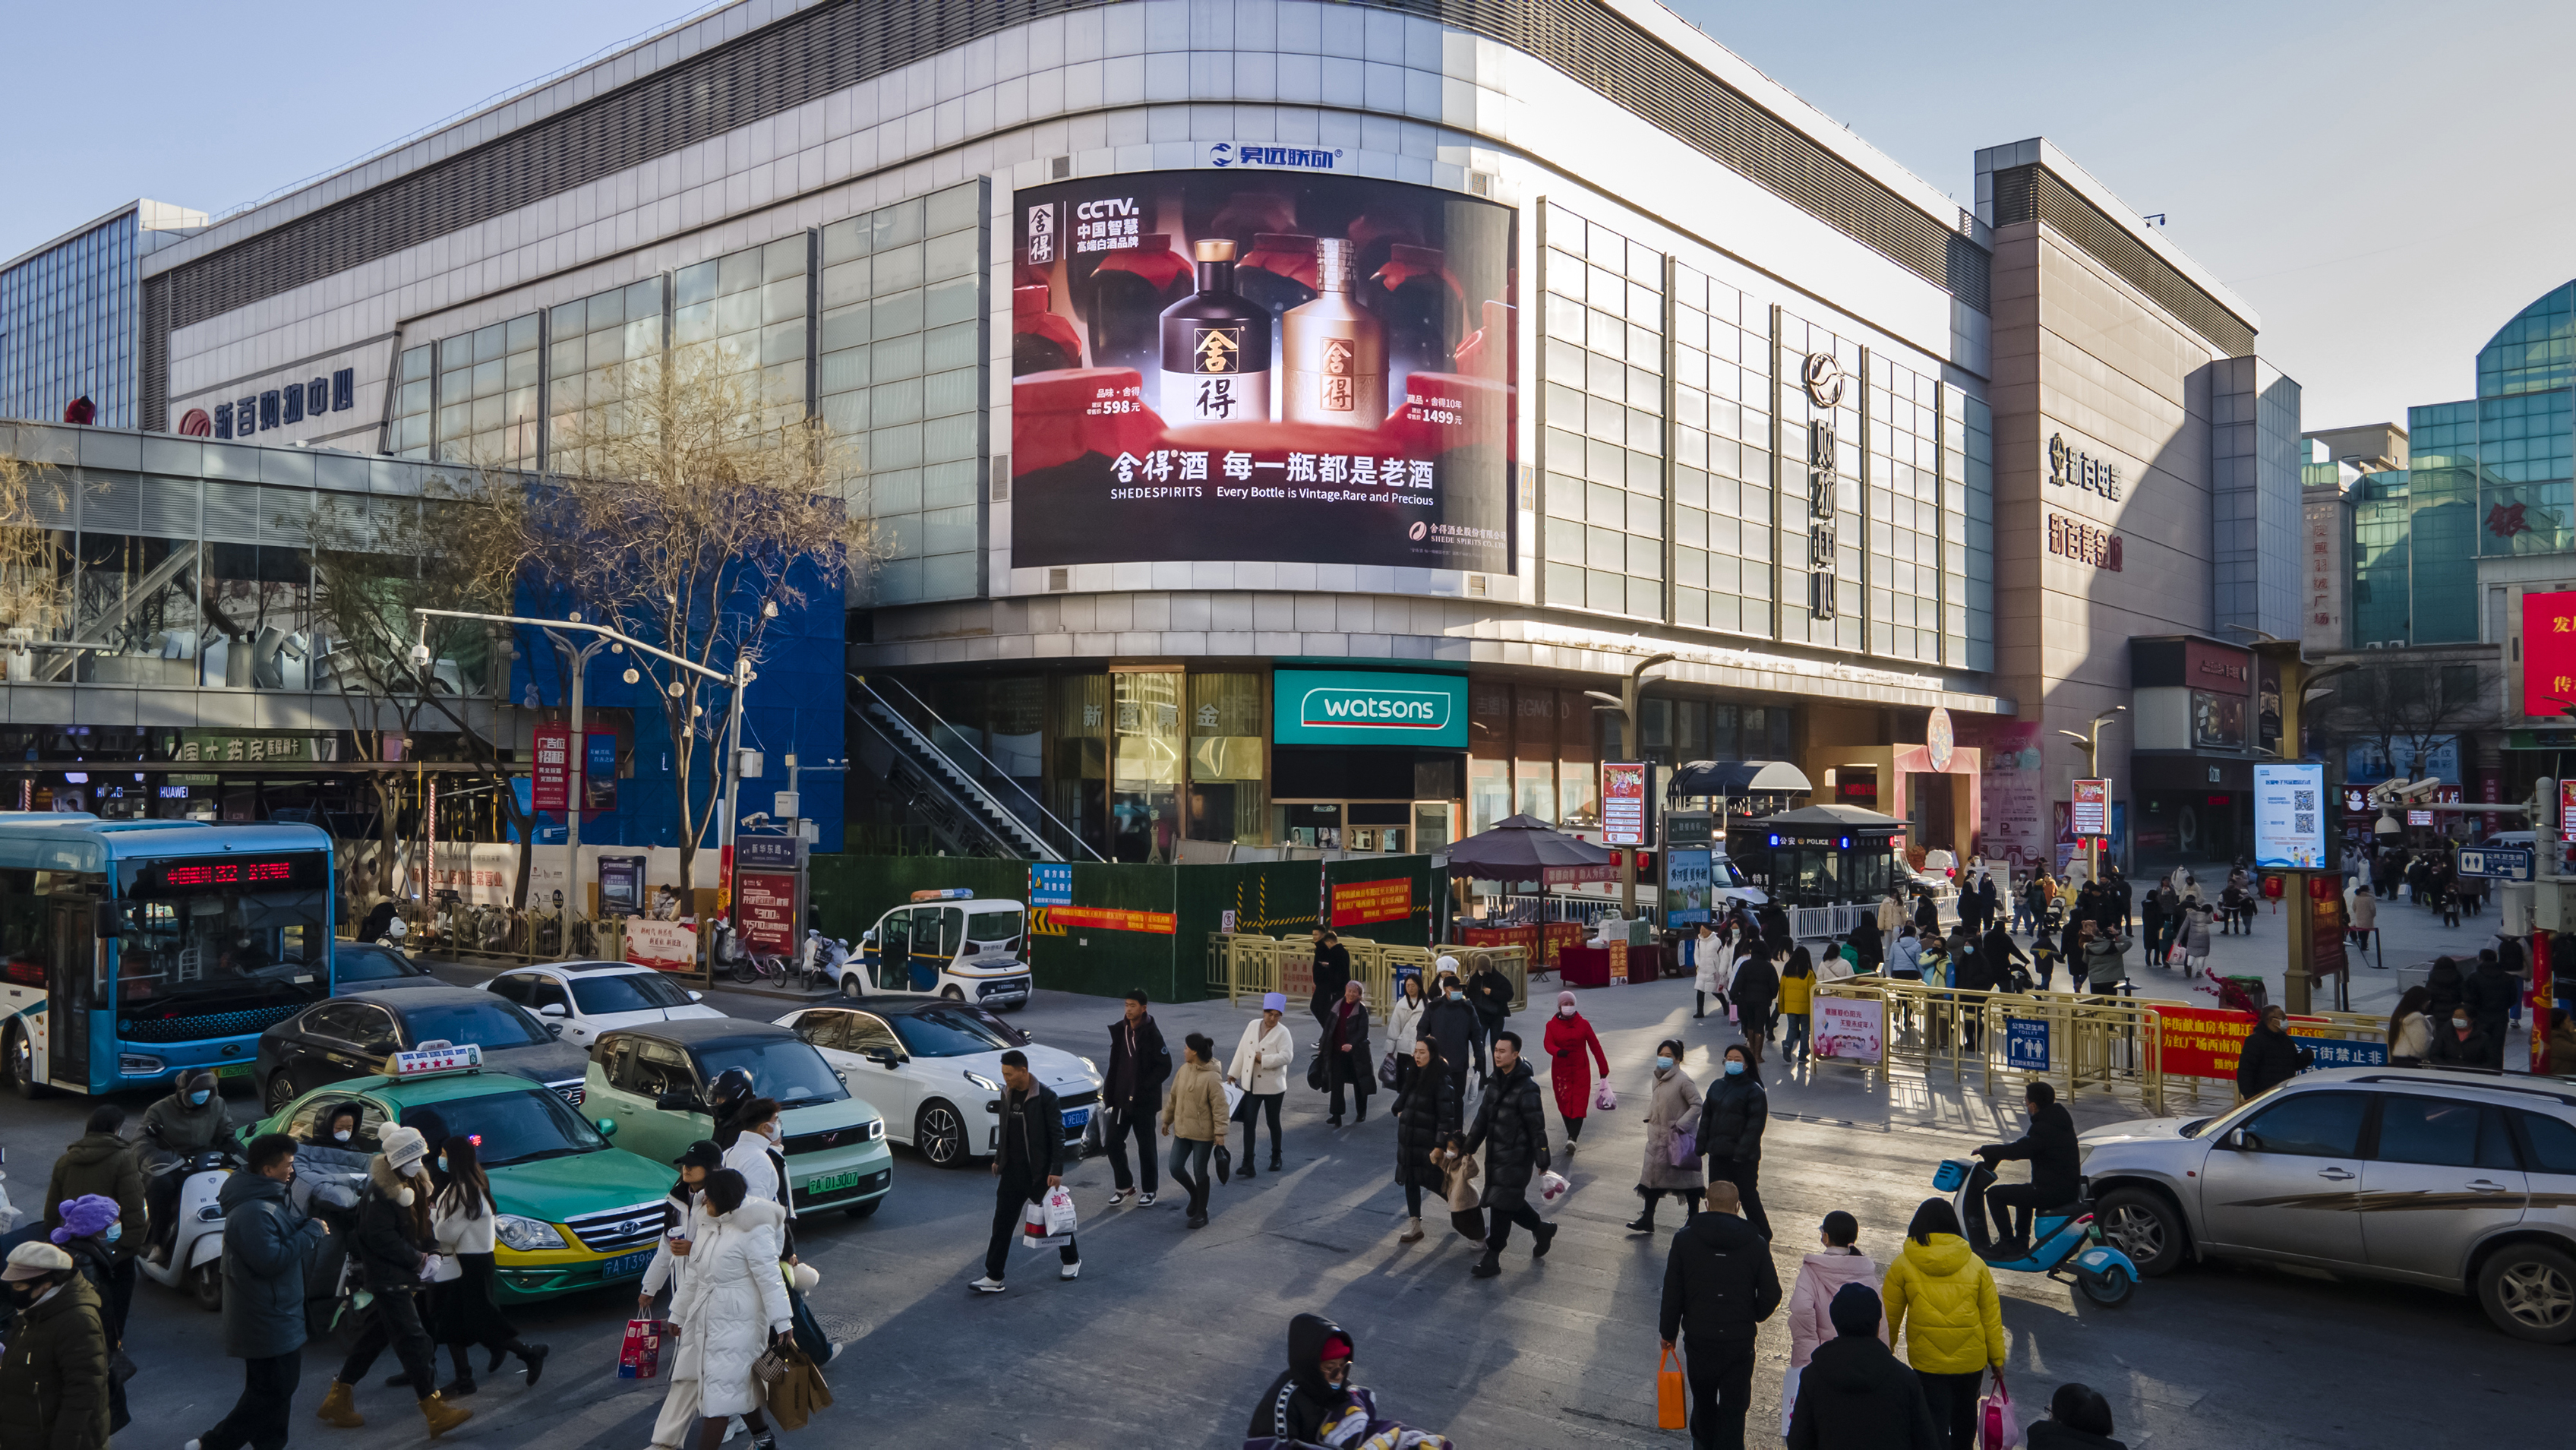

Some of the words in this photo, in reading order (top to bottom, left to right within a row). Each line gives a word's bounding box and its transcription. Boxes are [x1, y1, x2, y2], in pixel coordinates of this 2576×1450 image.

[1077, 218, 1138, 239] 中国智慧
[1077, 236, 1139, 253] 高端白酒品牌
[214, 367, 354, 440] 新百购物中心
[1222, 450, 1434, 489] 每一瓶都是老酒
[2066, 445, 2122, 502] 新百电器
[1110, 486, 1203, 499] SHEDESPIRITS
[1217, 486, 1249, 499] Every
[1251, 486, 1286, 498] Bottle
[1288, 488, 1297, 499] is
[1369, 491, 1389, 503] and
[1391, 492, 1434, 506] Precious
[1431, 535, 1454, 544] SHEDE
[1457, 538, 1482, 546] SPIRITS
[1324, 697, 1434, 719] watsons
[267, 738, 299, 756] 医保刷卡
[538, 738, 566, 749] 广告位
[538, 750, 565, 764] 招租
[159, 786, 189, 798] HUAWEI
[1779, 837, 1796, 845] 公安
[216, 864, 238, 882] 32
[2012, 1022, 2044, 1032] 公共卫生间
[2150, 1016, 2252, 1037] 华街献血房车搬迁
